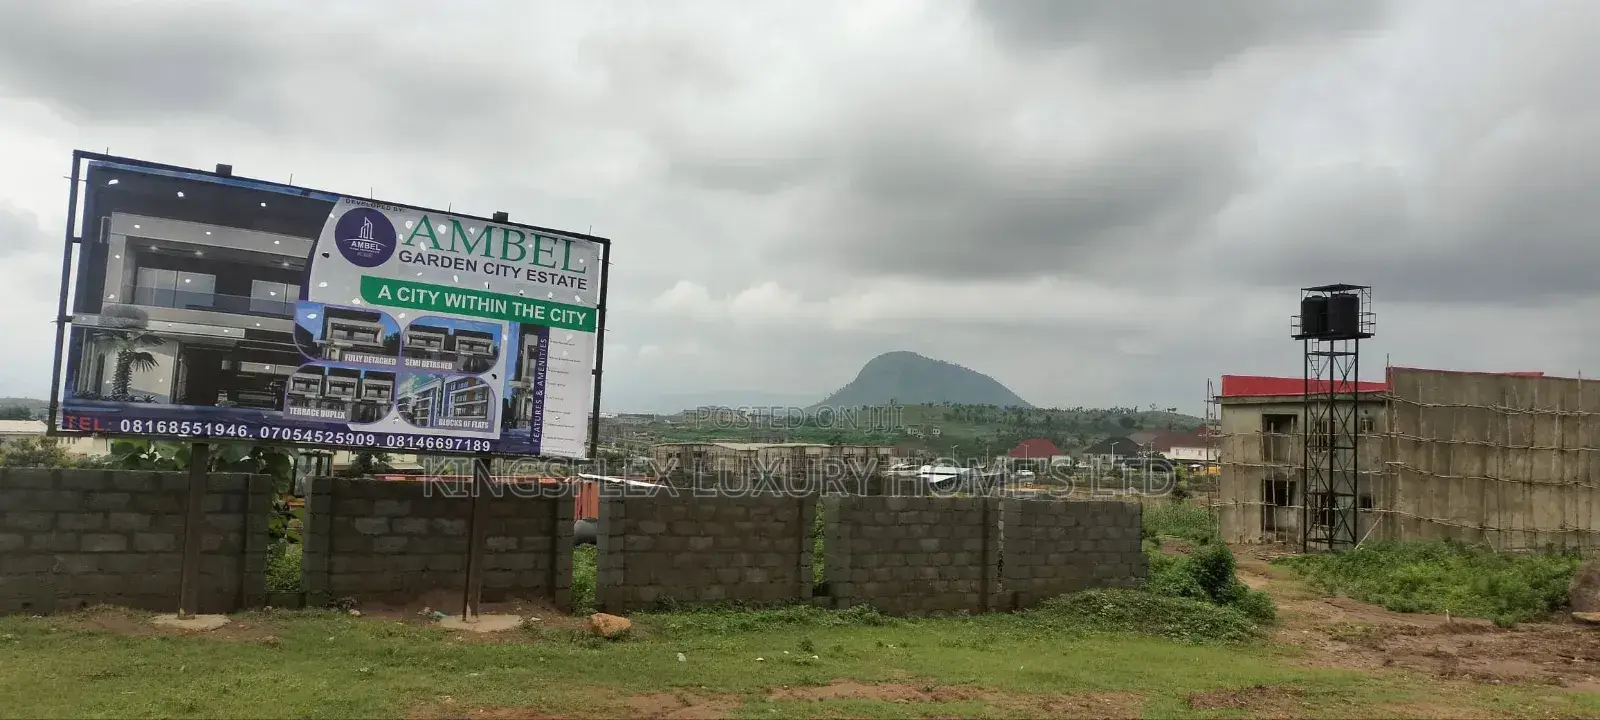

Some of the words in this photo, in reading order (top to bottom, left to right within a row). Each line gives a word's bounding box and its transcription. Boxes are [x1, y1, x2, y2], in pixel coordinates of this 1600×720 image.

[351, 241, 381, 251] AMBEL
[401, 214, 587, 274] AMBEL
[399, 250, 477, 272] GARDEN
[483, 262, 522, 279] CITY
[526, 270, 587, 290] ESTATE
[378, 285, 391, 299] A
[397, 288, 439, 304] CITY
[445, 293, 508, 315] WITHIN
[512, 302, 545, 320] THE
[550, 308, 587, 326] CITY
[345, 354, 363, 364] FULLY
[363, 355, 397, 366] DETACHED
[405, 358, 421, 367] SEMI
[537, 338, 547, 386] AMENITIES
[290, 407, 320, 417] TERRACE
[320, 410, 346, 419] DUPLEX
[533, 399, 542, 443] FEATURES
[439, 419, 462, 428] BLOCKS
[462, 420, 471, 428] OF
[471, 421, 489, 430] FLATS
[386, 436, 491, 452] 08146697189
